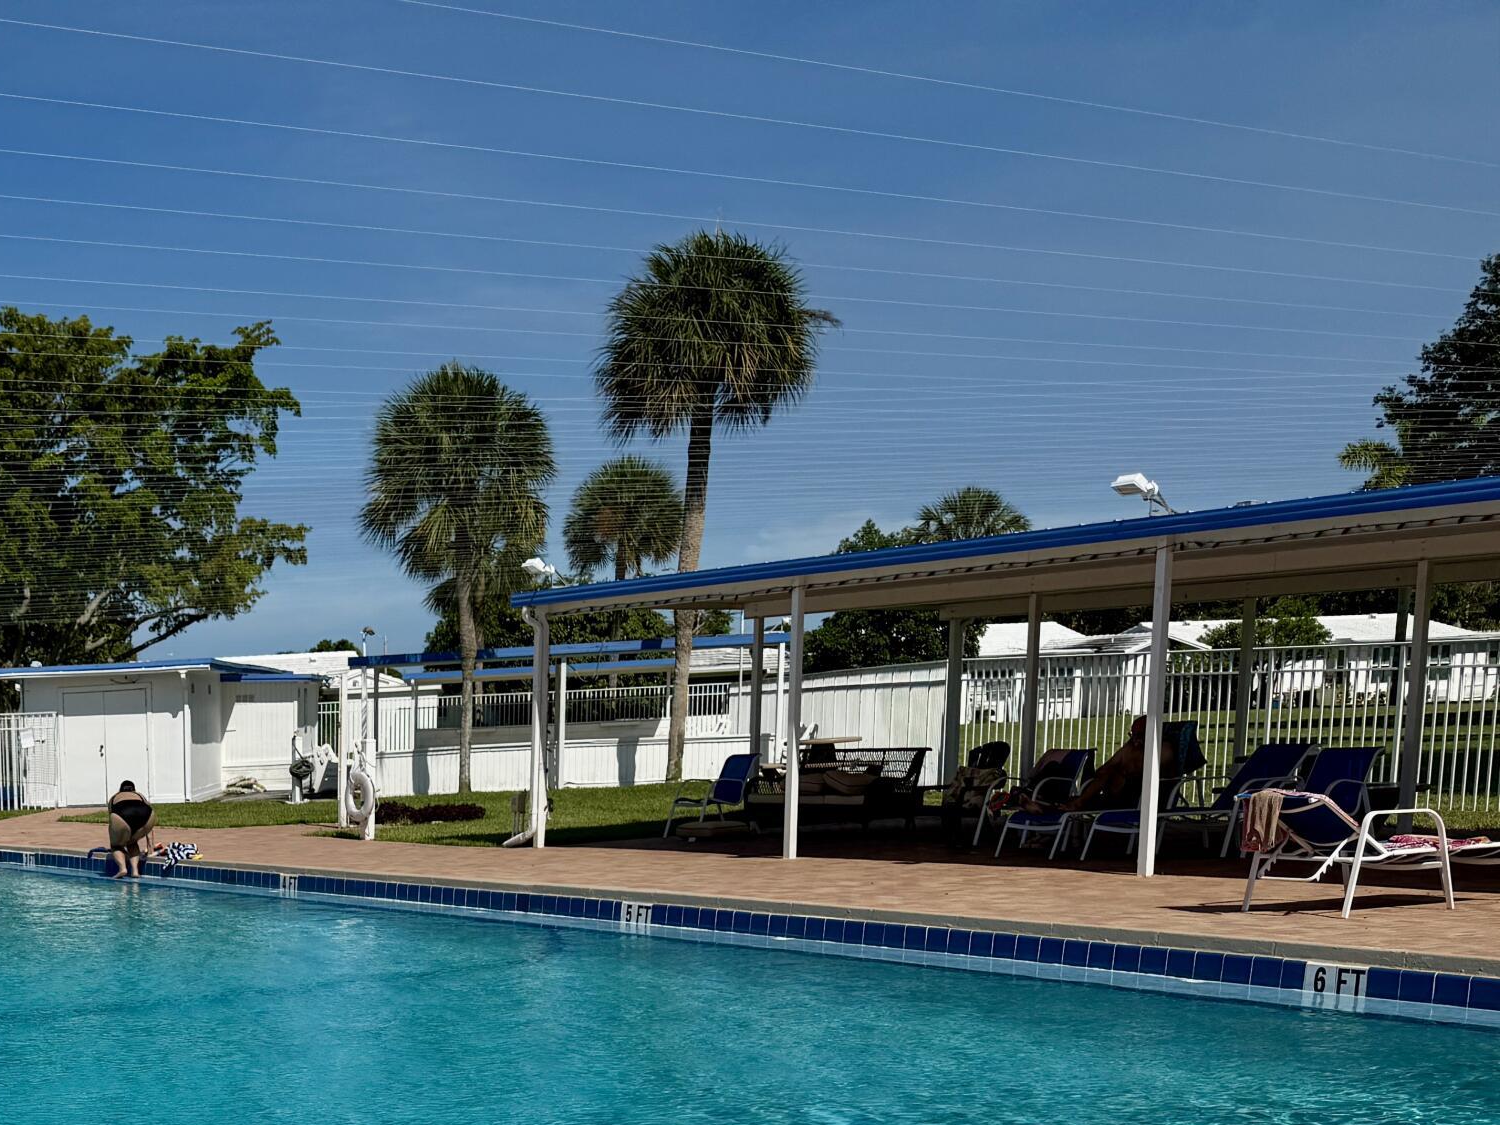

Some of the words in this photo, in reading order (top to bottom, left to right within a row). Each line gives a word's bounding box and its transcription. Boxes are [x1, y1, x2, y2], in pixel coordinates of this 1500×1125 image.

[626, 904, 632, 922] 5
[636, 905, 651, 924] FT
[1314, 967, 1327, 993] 6
[1336, 968, 1366, 996] FT
